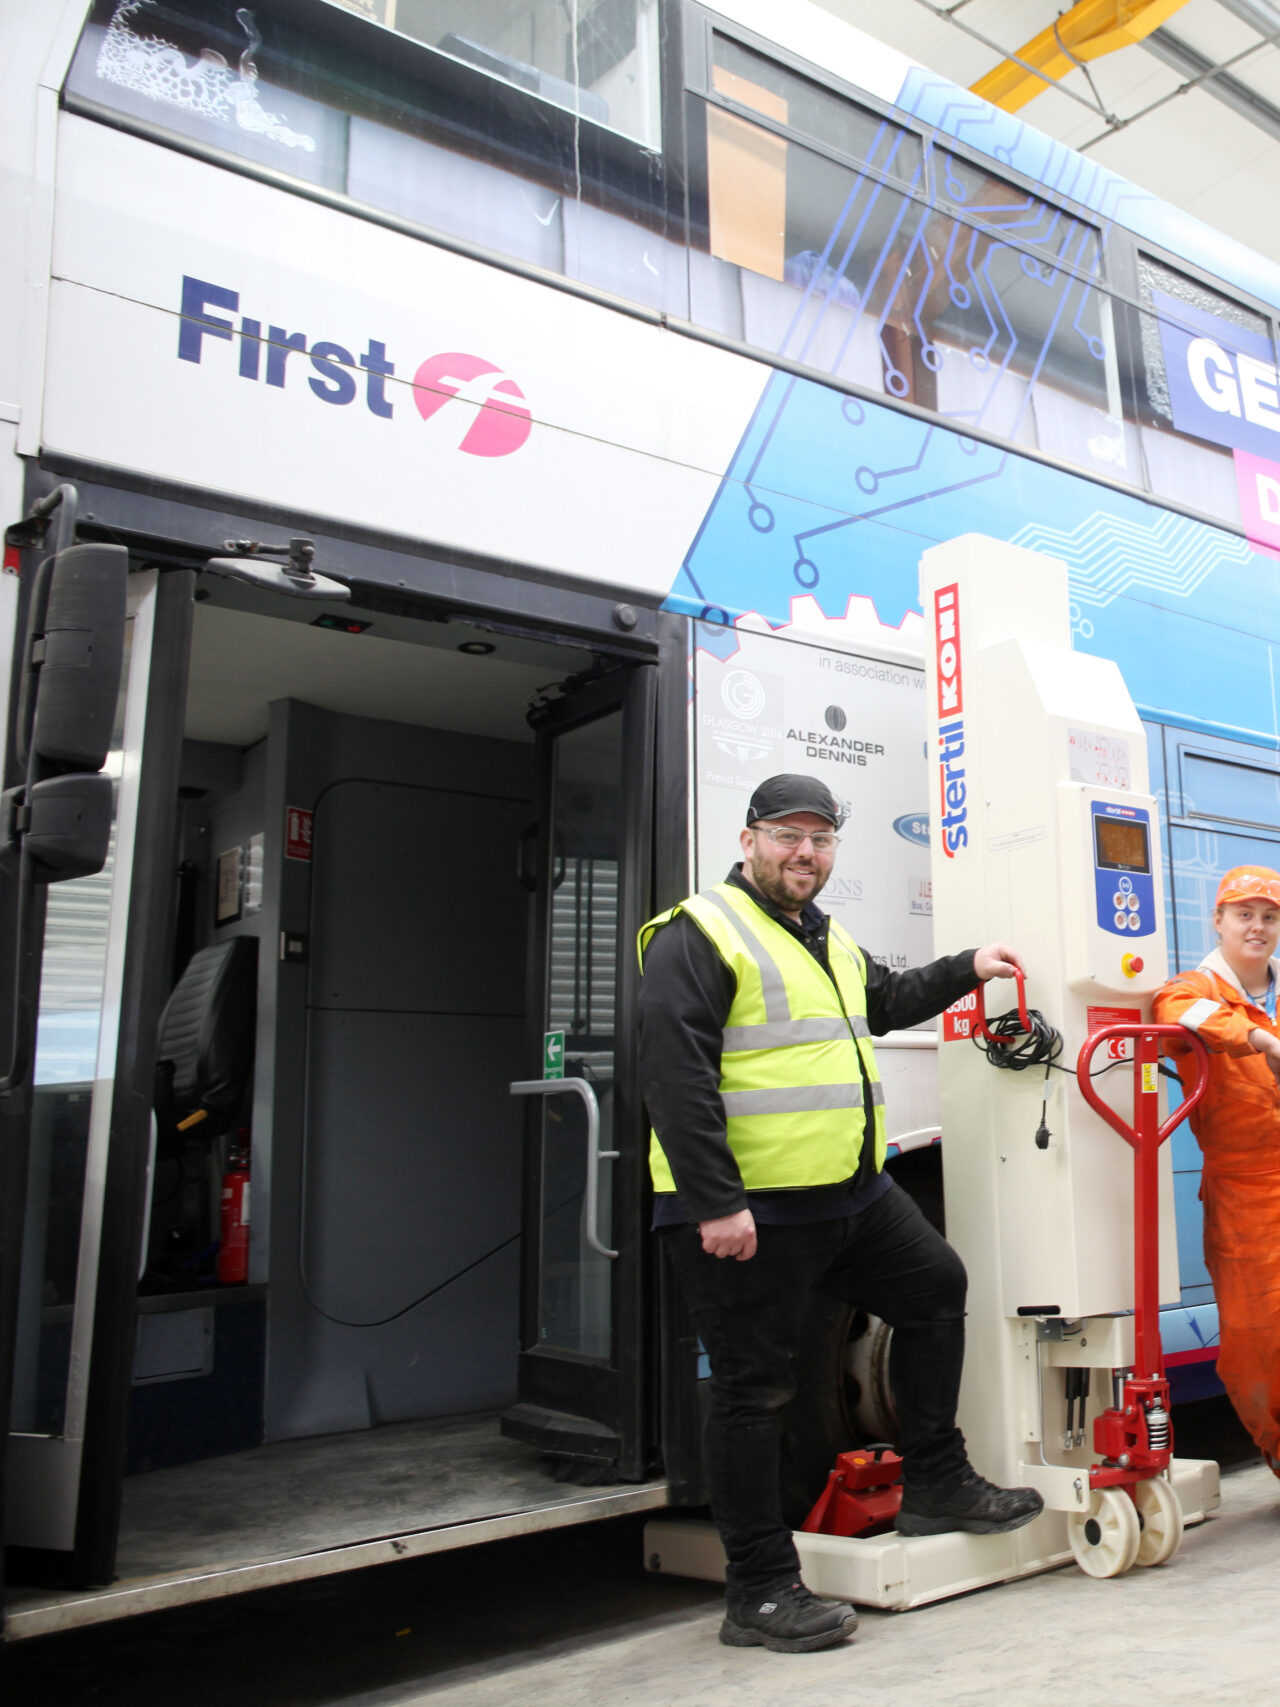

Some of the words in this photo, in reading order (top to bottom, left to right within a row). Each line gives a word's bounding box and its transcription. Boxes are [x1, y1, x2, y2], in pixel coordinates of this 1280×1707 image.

[178, 275, 395, 420] First
[938, 591, 959, 712] KONI
[819, 654, 830, 669] in
[835, 660, 909, 687] association
[702, 714, 758, 735] GLASGOW
[786, 728, 885, 756] ALEXANDER
[806, 746, 868, 767] DENNIS
[939, 720, 968, 854] stertil
[890, 952, 910, 968] Ltd.
[953, 1016, 970, 1036] kg
